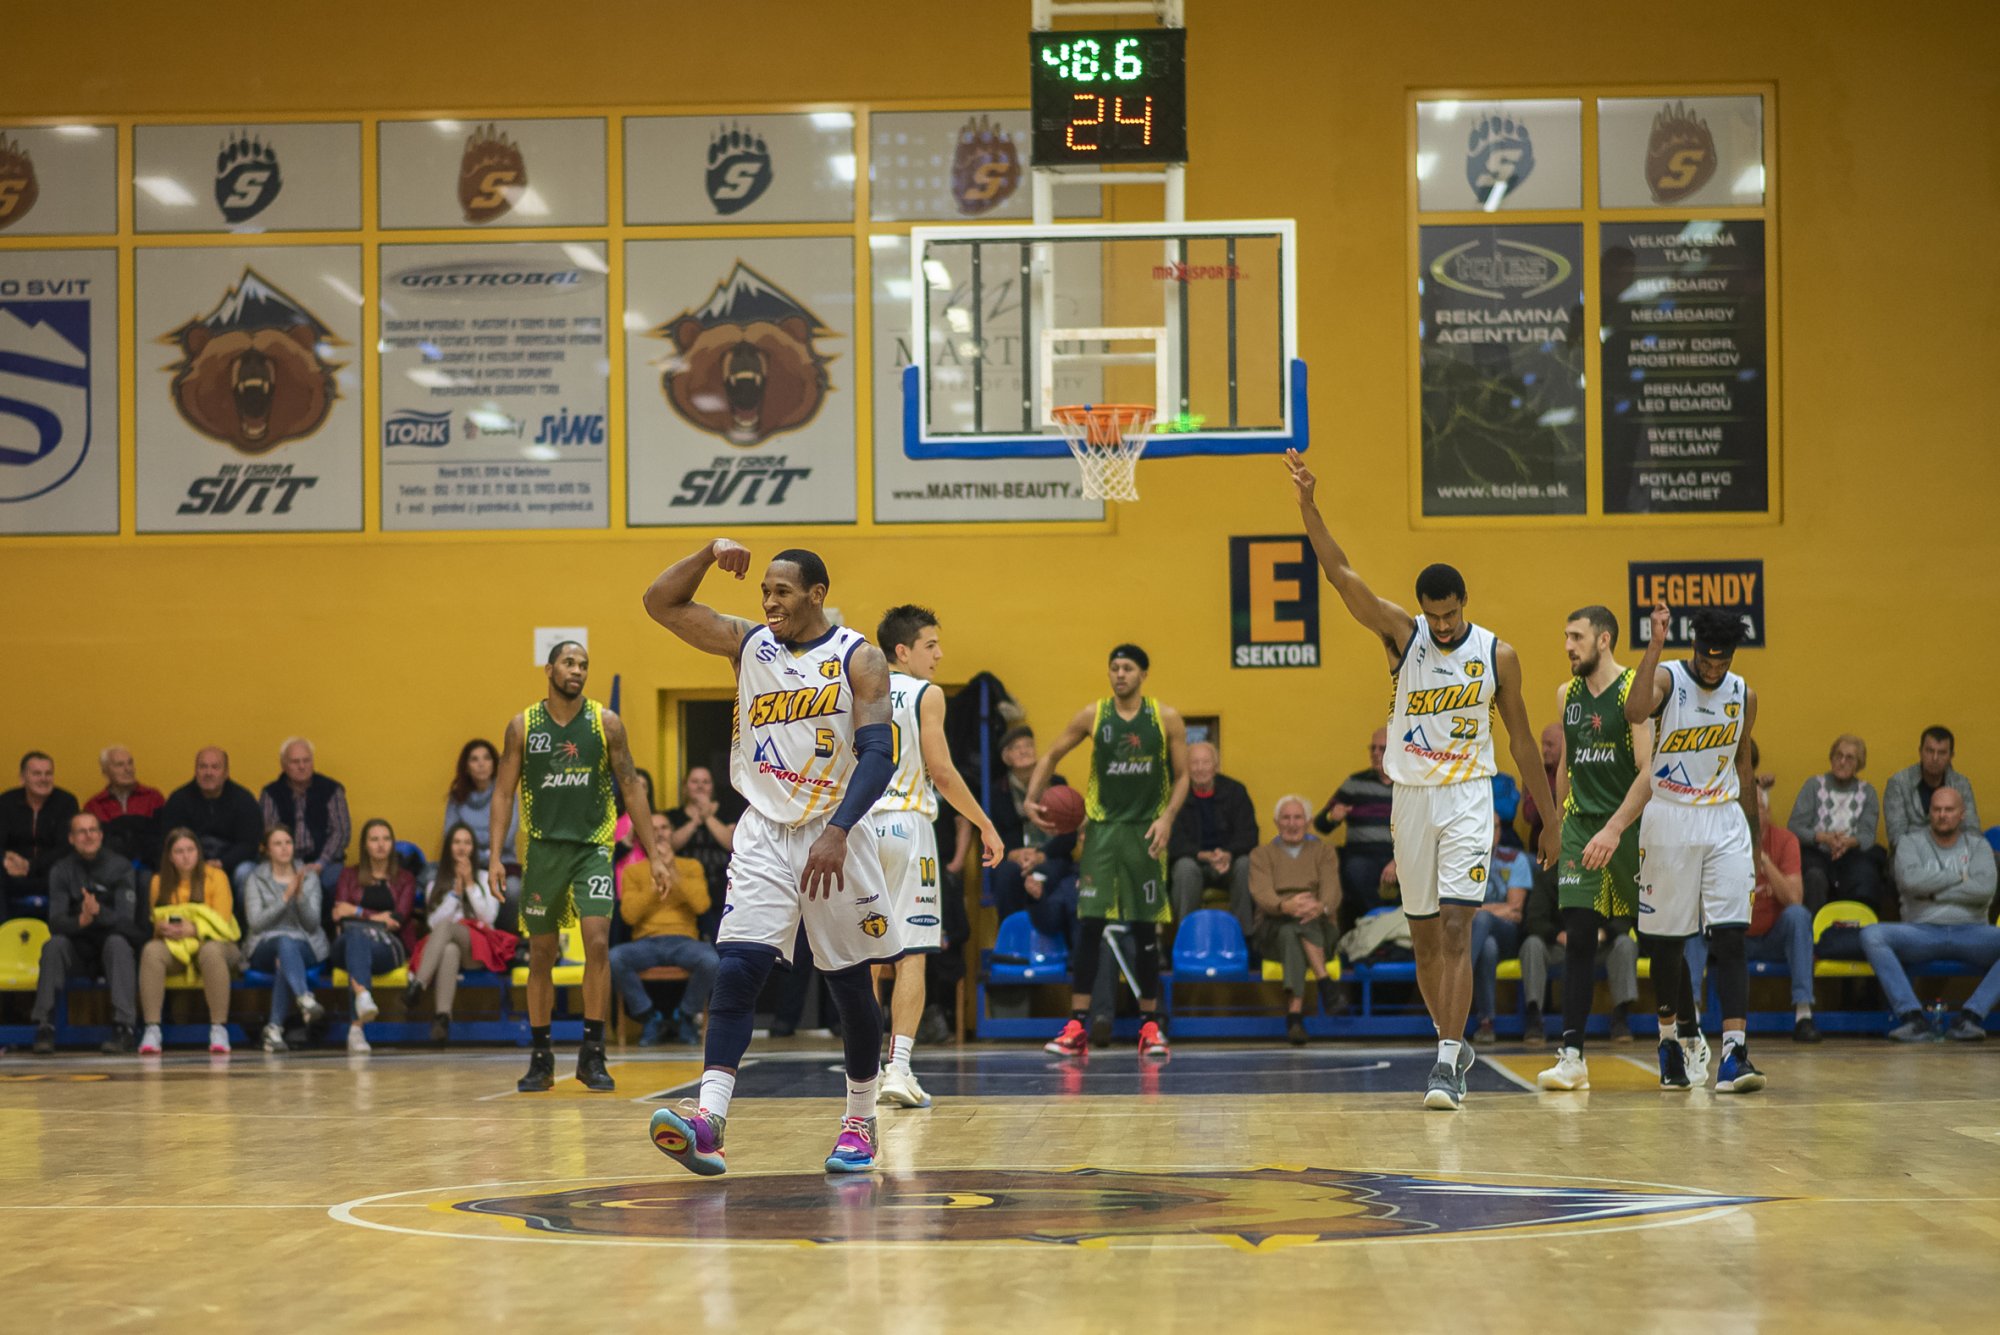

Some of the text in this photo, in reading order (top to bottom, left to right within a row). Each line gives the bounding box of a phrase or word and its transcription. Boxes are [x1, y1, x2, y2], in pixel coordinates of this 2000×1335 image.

[1066, 94, 1152, 150] 24
[27, 279, 91, 295] SVIT
[401, 272, 581, 288] GASTROBAL
[388, 422, 447, 444] TORK
[176, 477, 318, 515] SVIT
[669, 468, 812, 507] SVIT
[1437, 483, 1568, 500] www.tojes.sk
[1249, 542, 1305, 643] E
[1636, 573, 1756, 607] LEGENDY
[1235, 645, 1317, 666] SEKTOR
[1405, 680, 1484, 716] ISKRA
[1566, 703, 1582, 725] 10
[1102, 724, 1112, 743] 1
[1450, 716, 1479, 740] 22
[529, 732, 551, 753] 22
[814, 728, 835, 758] 5
[1715, 755, 1729, 776] 7
[919, 857, 936, 887] 10
[588, 876, 613, 899] 22
[1143, 880, 1156, 904] 1
